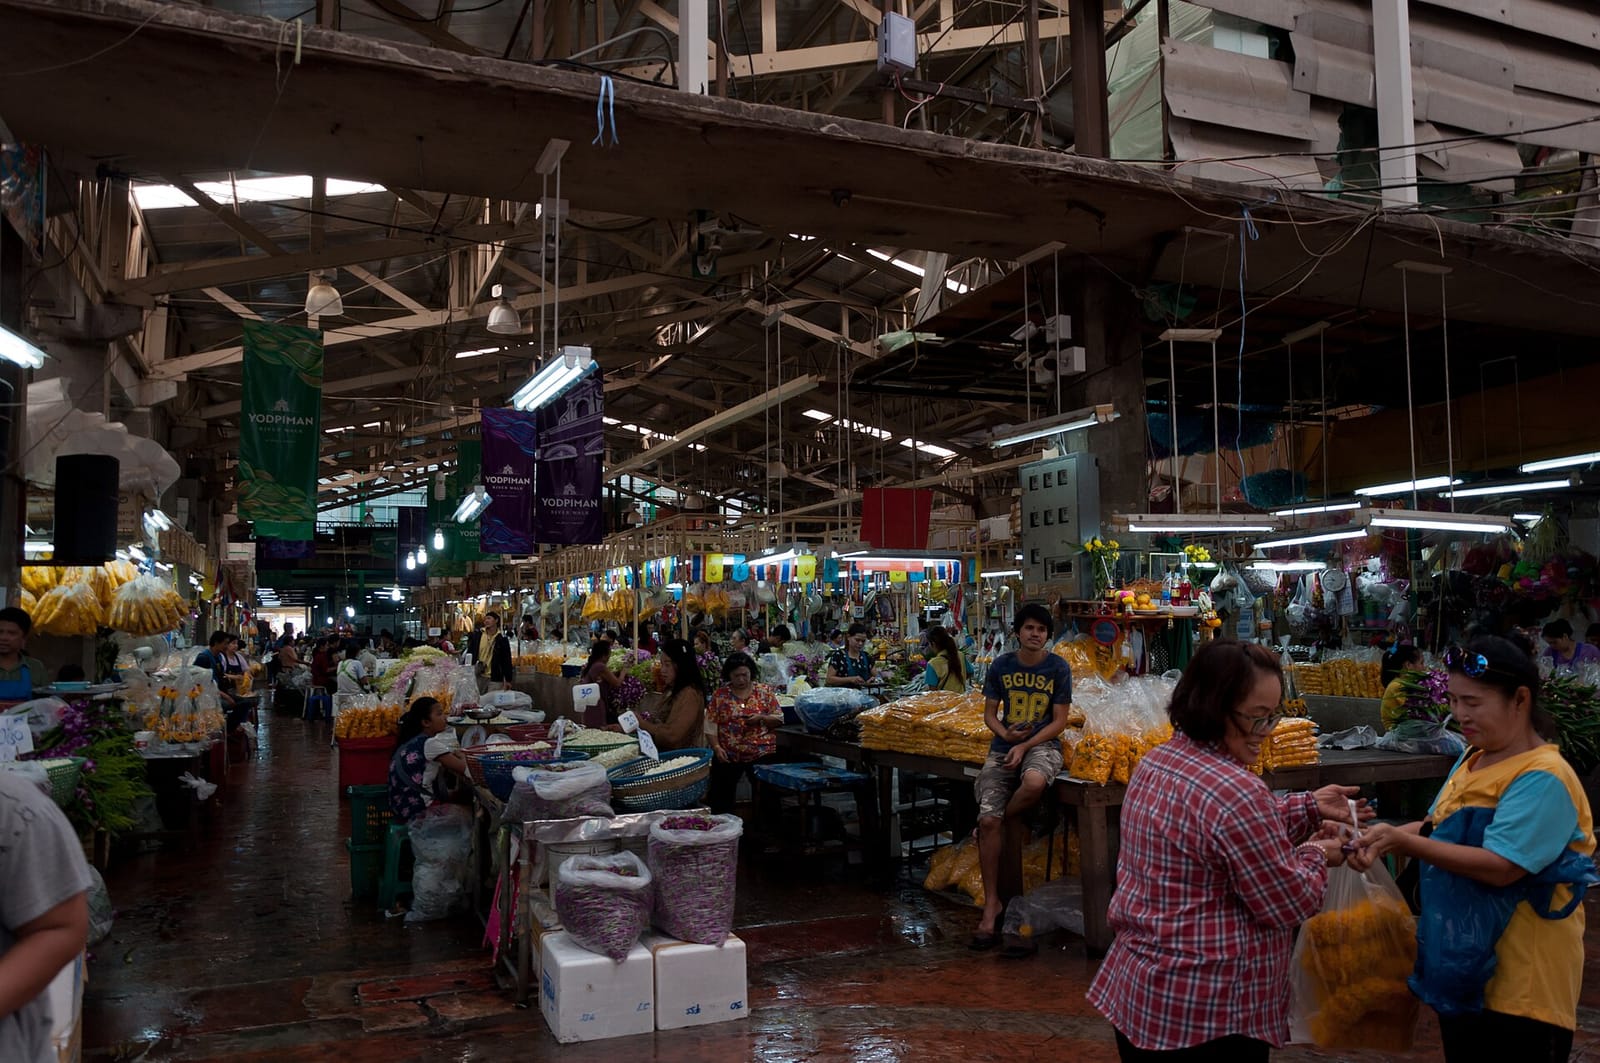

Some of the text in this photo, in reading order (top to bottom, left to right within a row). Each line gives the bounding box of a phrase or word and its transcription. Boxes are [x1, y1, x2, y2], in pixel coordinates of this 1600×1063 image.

[248, 413, 314, 425] YODPIMAN
[485, 476, 530, 484] YODPIMAN
[541, 497, 598, 508] YODPIMAN
[1002, 672, 1054, 694] BGUSA
